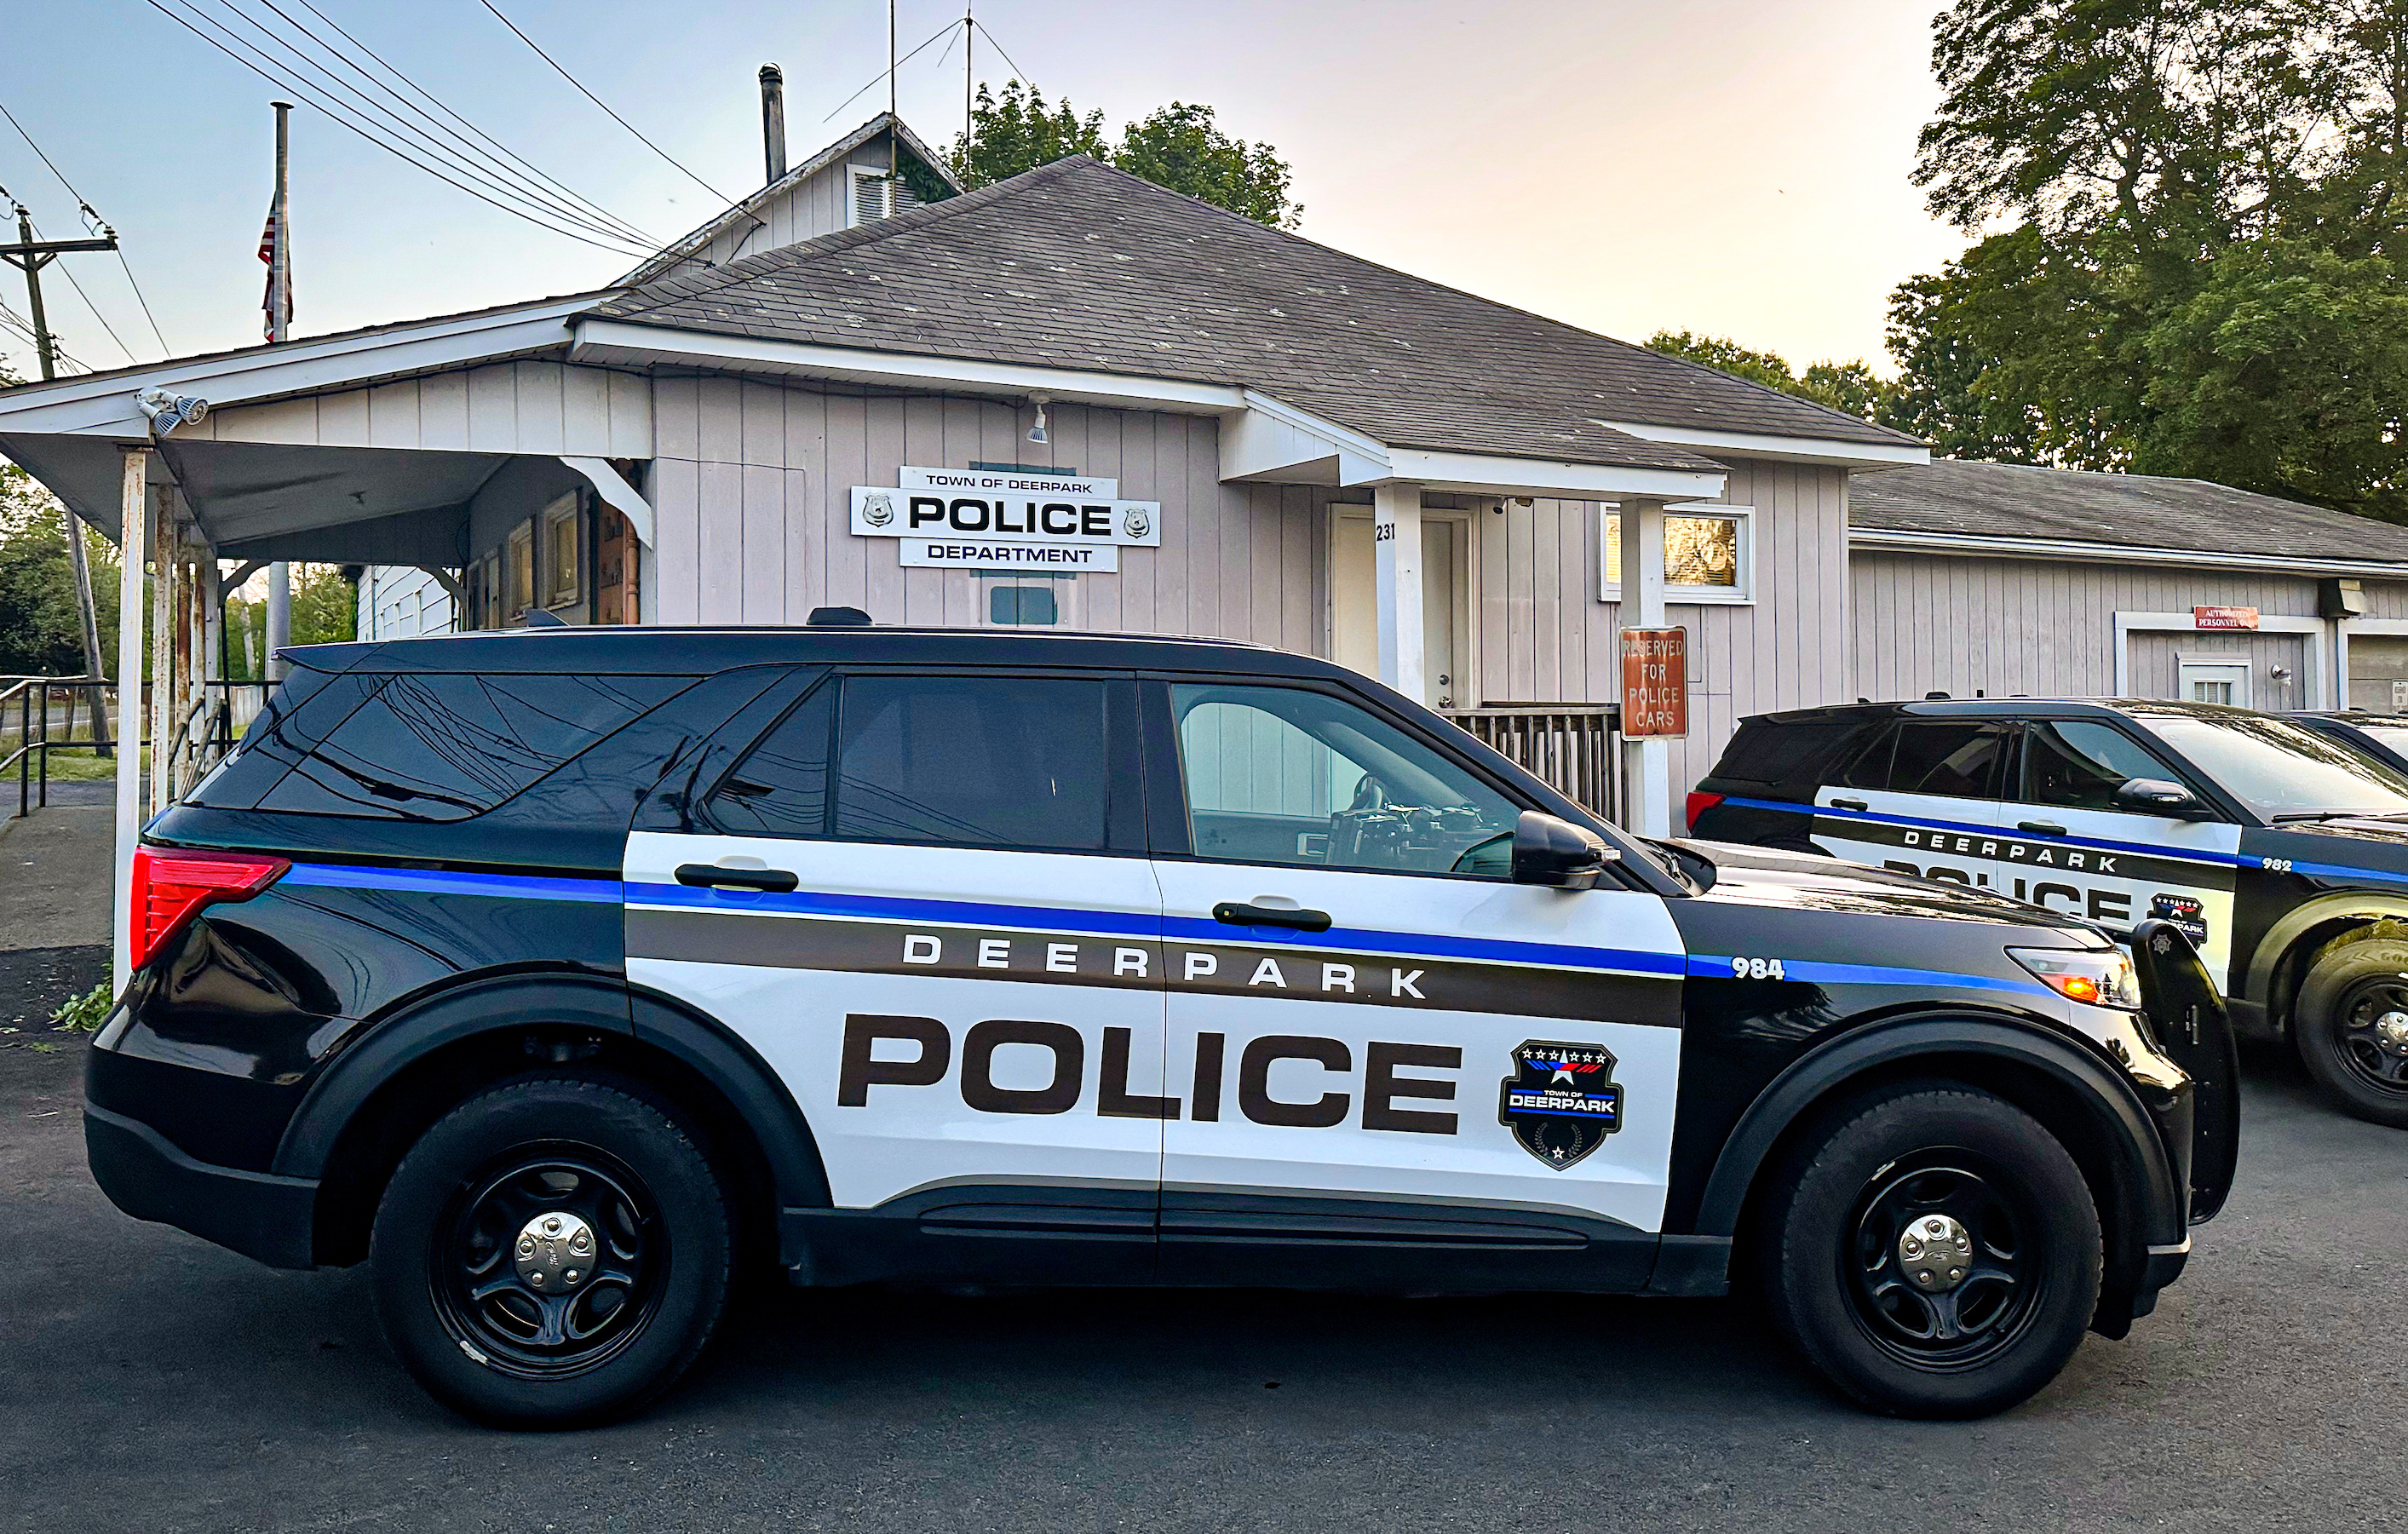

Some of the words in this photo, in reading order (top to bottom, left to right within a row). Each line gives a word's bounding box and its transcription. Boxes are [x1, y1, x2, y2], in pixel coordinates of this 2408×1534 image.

[927, 474, 975, 487] TOWN
[981, 478, 1003, 488] OF
[1009, 480, 1093, 494] DEERPARK
[909, 497, 1112, 537] POLICE
[1376, 522, 1395, 542] 231
[928, 544, 1093, 563] DEPARTMENT
[2198, 618, 2238, 627] PERSONNEL
[1623, 639, 1683, 657] RESERVED
[1641, 664, 1666, 681] FOR
[1629, 687, 1680, 704] POLICE
[1636, 710, 1675, 727] CARS
[1904, 830, 2117, 873] DEERPARK
[2261, 857, 2293, 872] 982
[901, 934, 1427, 999] DEERPARK
[1731, 957, 1785, 980] 984
[836, 1013, 1463, 1135] POLICE
[1543, 1089, 1569, 1098] TOWN
[1509, 1094, 1615, 1113] DEERPARK
